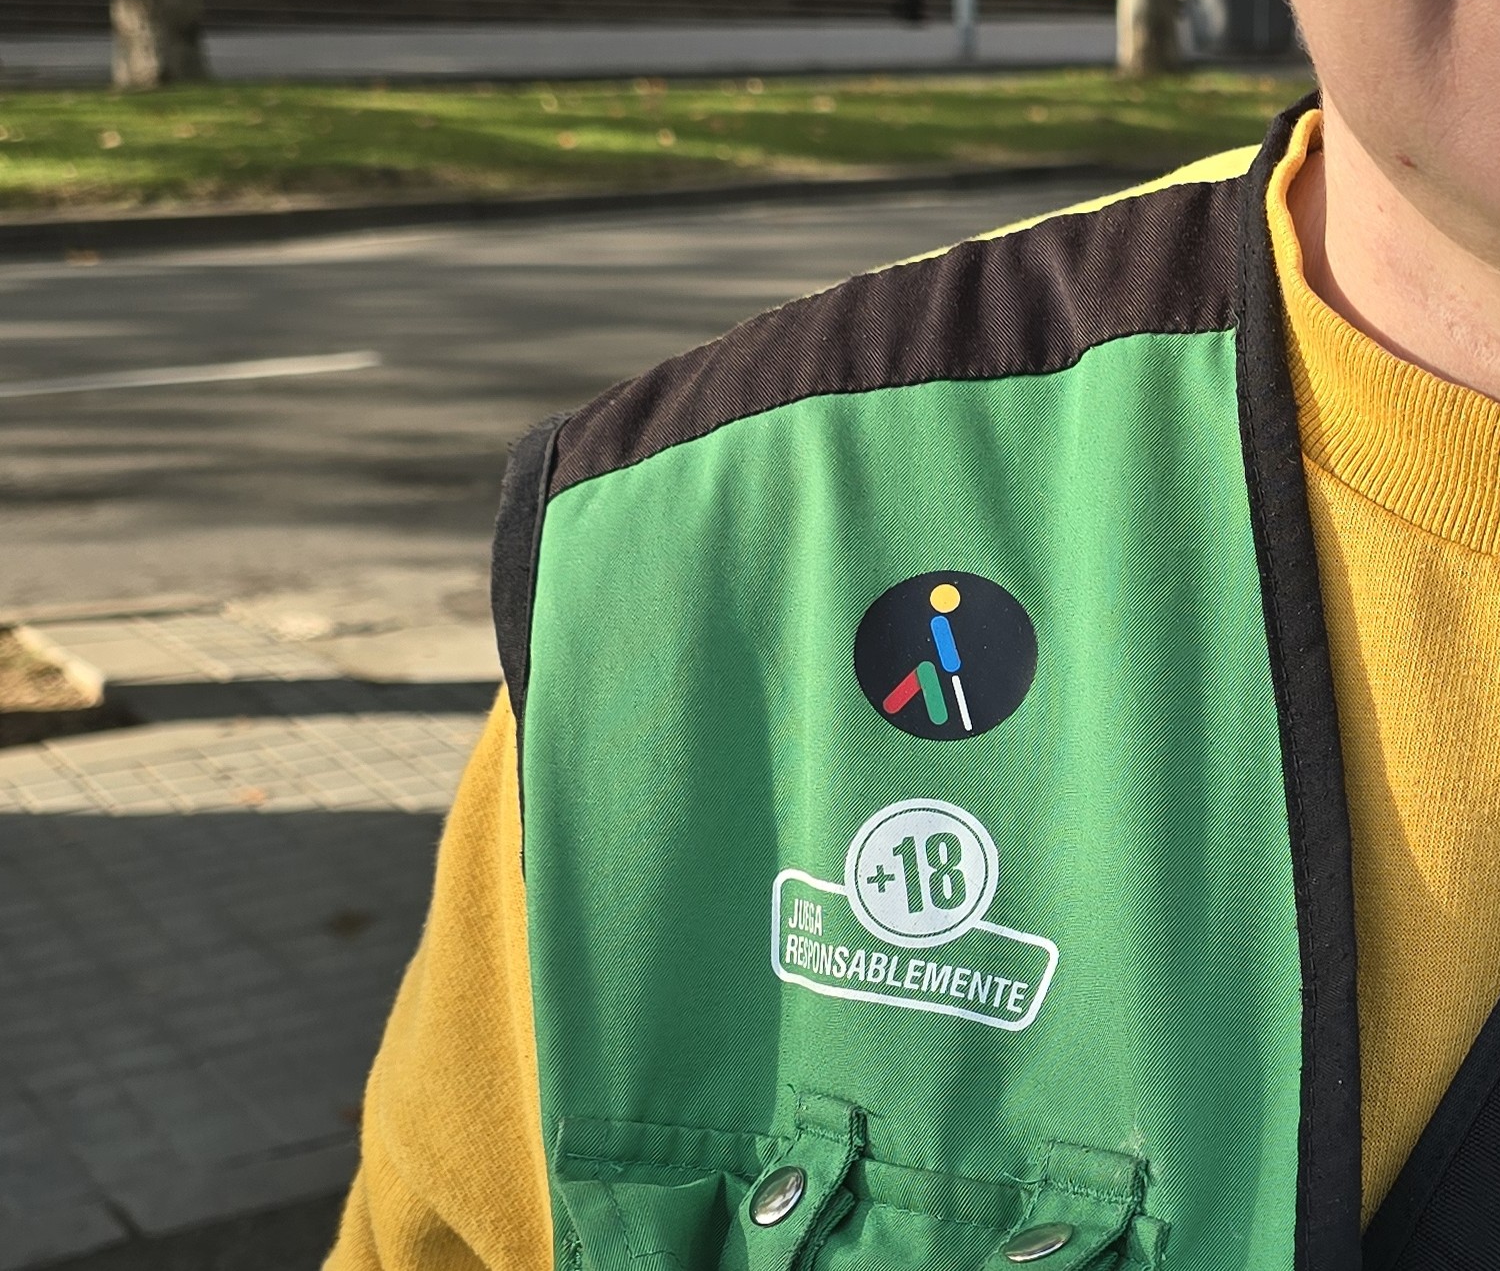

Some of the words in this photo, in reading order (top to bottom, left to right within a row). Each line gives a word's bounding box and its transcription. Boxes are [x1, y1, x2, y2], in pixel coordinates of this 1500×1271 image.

[866, 831, 967, 915] +18
[788, 898, 823, 936] JUEGA
[785, 933, 1029, 1014] RESPONSABLEMENTE
